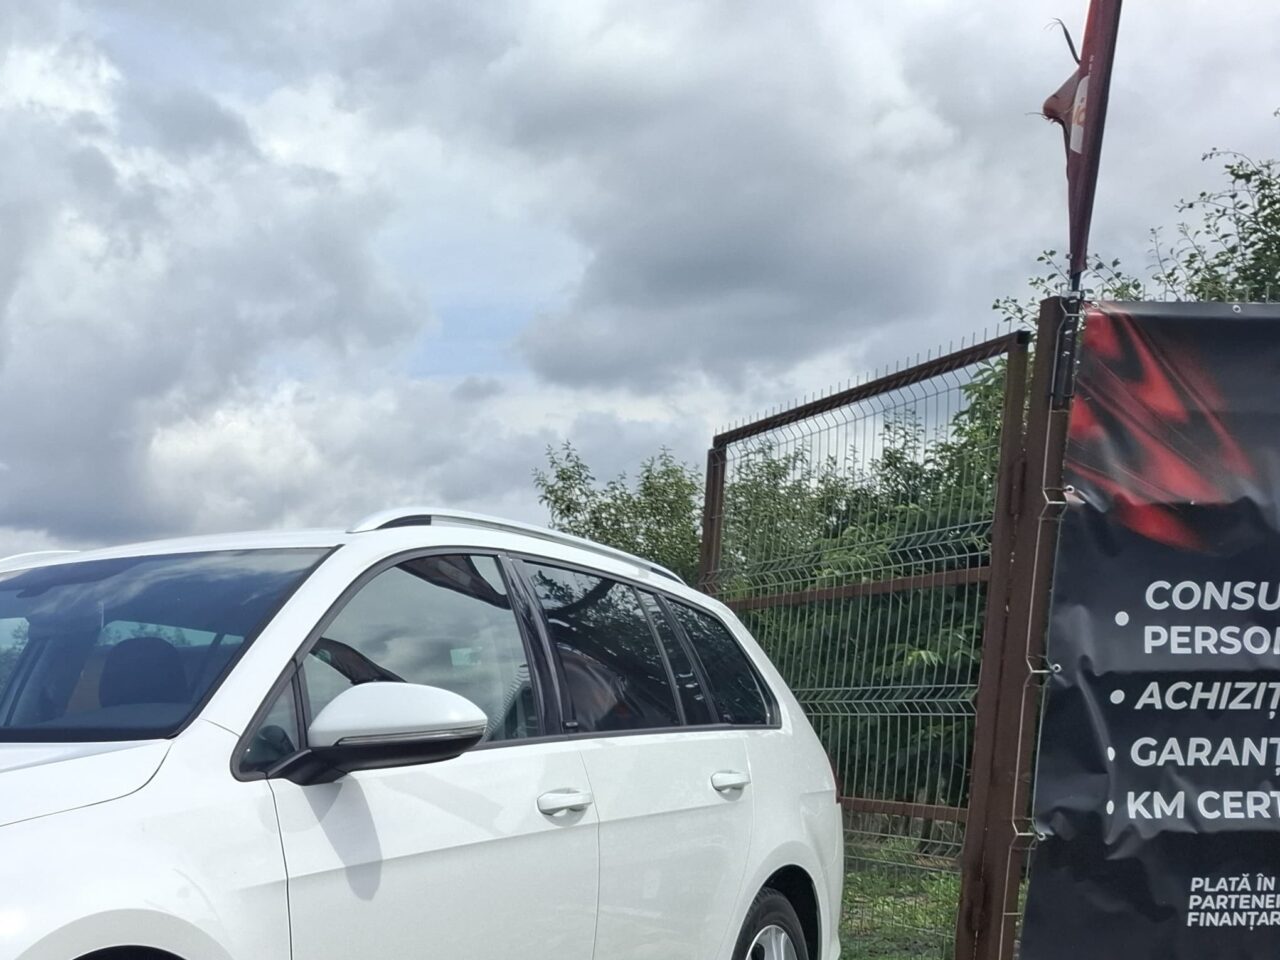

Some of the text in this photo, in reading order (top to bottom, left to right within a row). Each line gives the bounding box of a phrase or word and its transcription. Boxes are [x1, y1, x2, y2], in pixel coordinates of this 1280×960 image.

[1145, 581, 1280, 611] CONSU
[1144, 626, 1280, 655] PERSO
[1127, 791, 1185, 819] KM
[1190, 873, 1276, 892] PLATĂ ÎN
[1187, 911, 1280, 931] FINANȚAR
